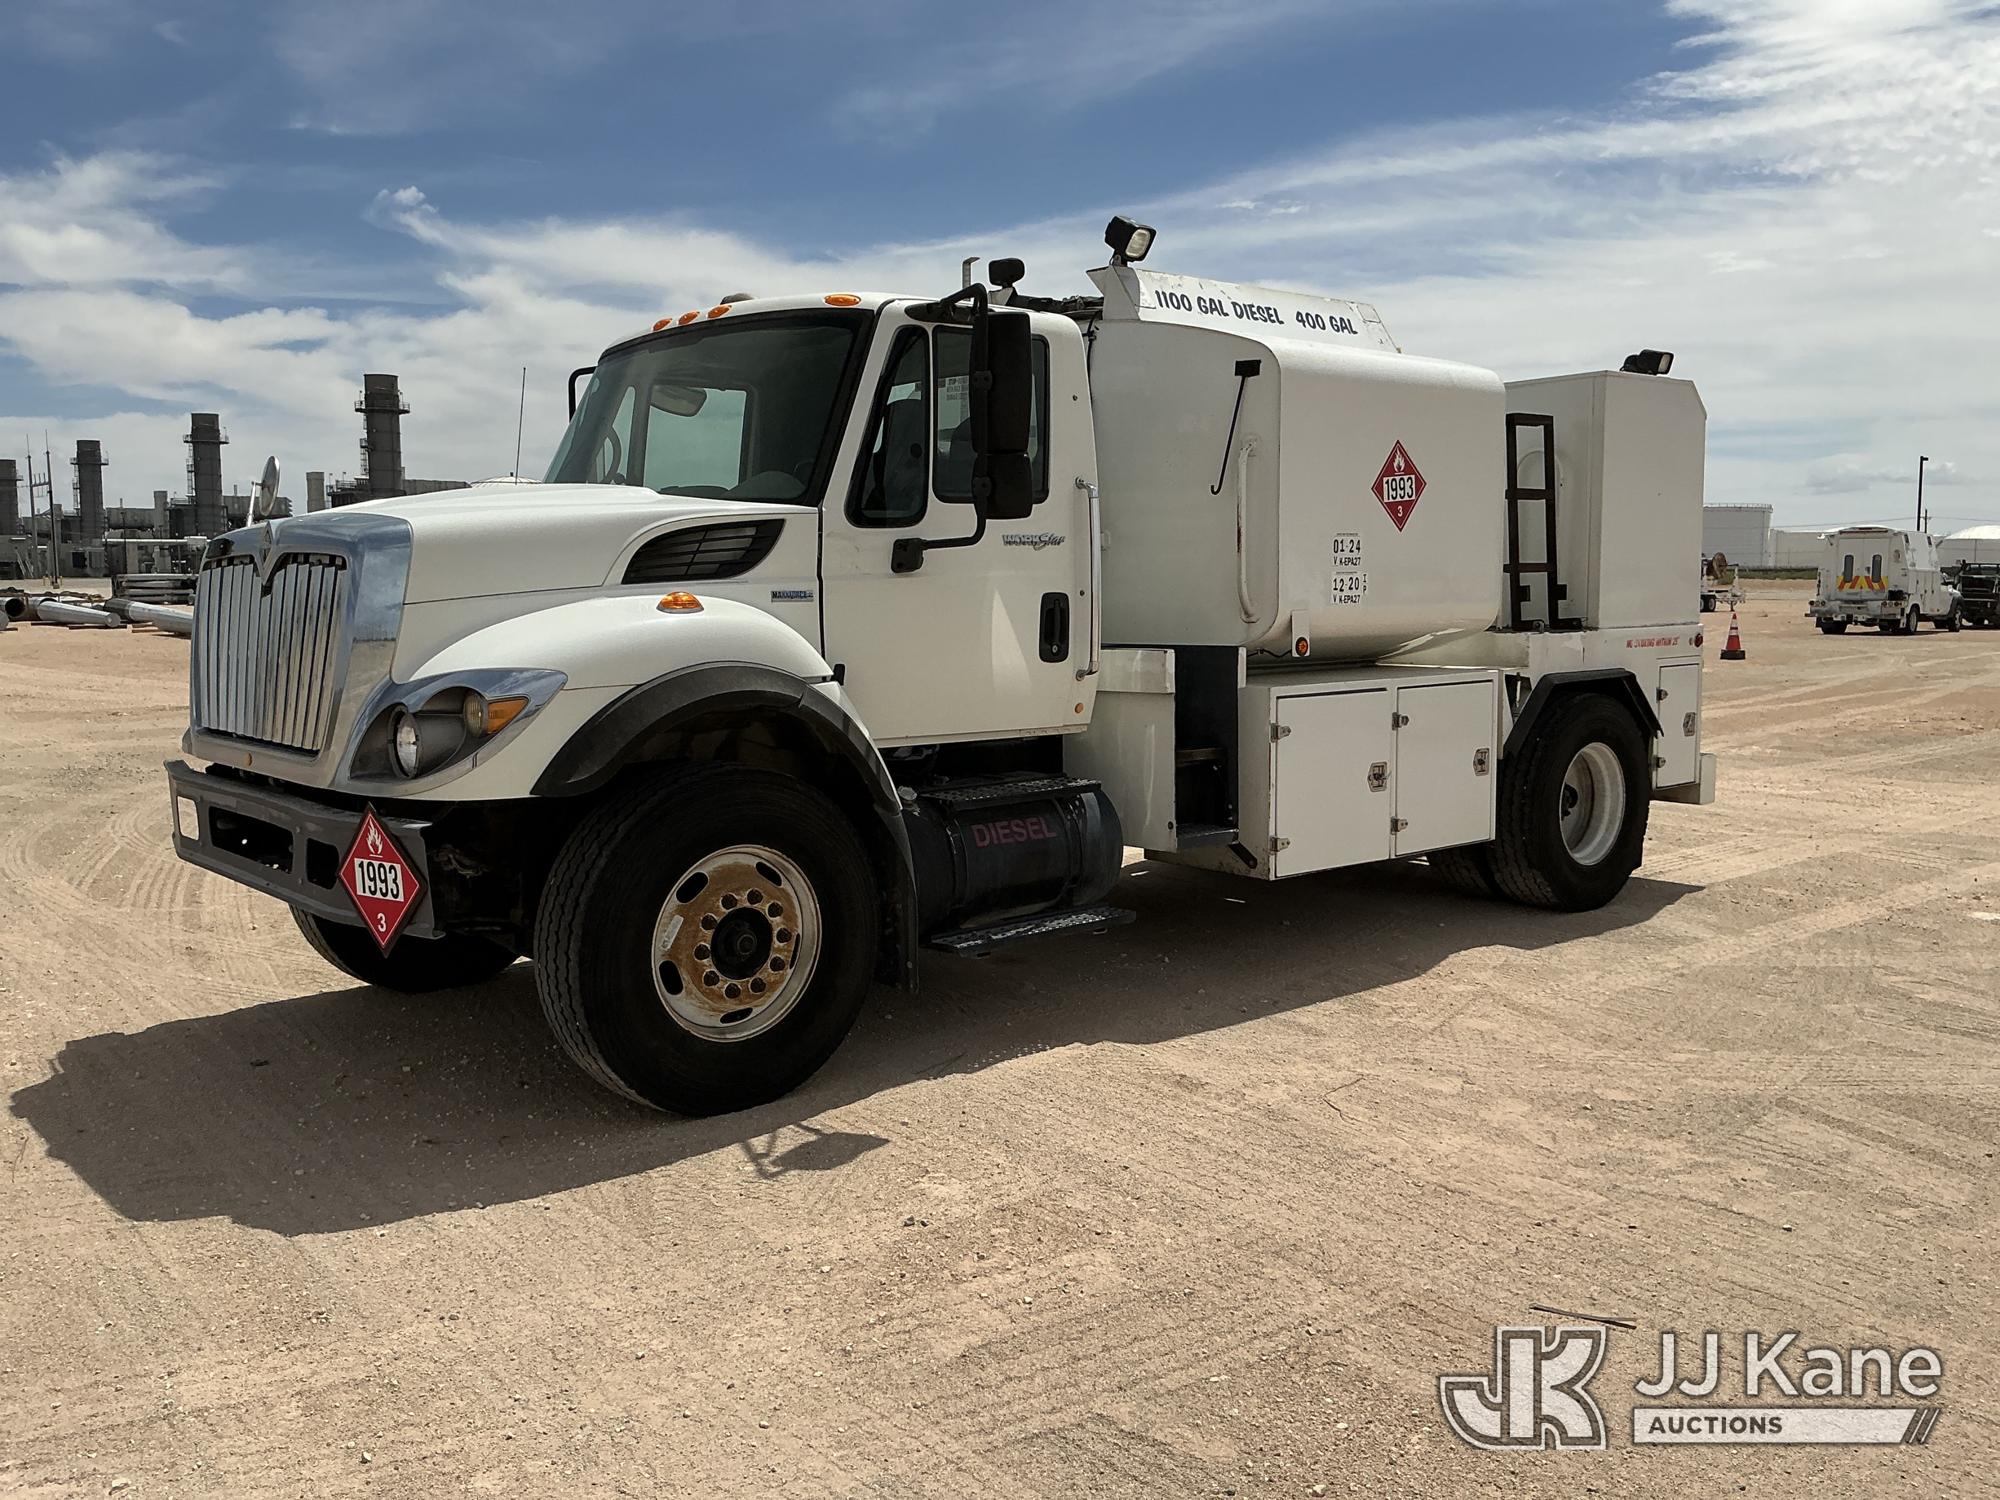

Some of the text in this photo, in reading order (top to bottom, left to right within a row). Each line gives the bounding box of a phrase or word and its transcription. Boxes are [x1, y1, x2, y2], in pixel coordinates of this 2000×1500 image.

[1155, 290, 1358, 335] 1100 GAL DIESEL 400 GAL
[1384, 476, 1414, 500] 1993
[1397, 505, 1403, 517] 3
[971, 816, 1057, 848] DIESEL
[358, 861, 400, 899] 1993
[376, 912, 387, 932] 3
